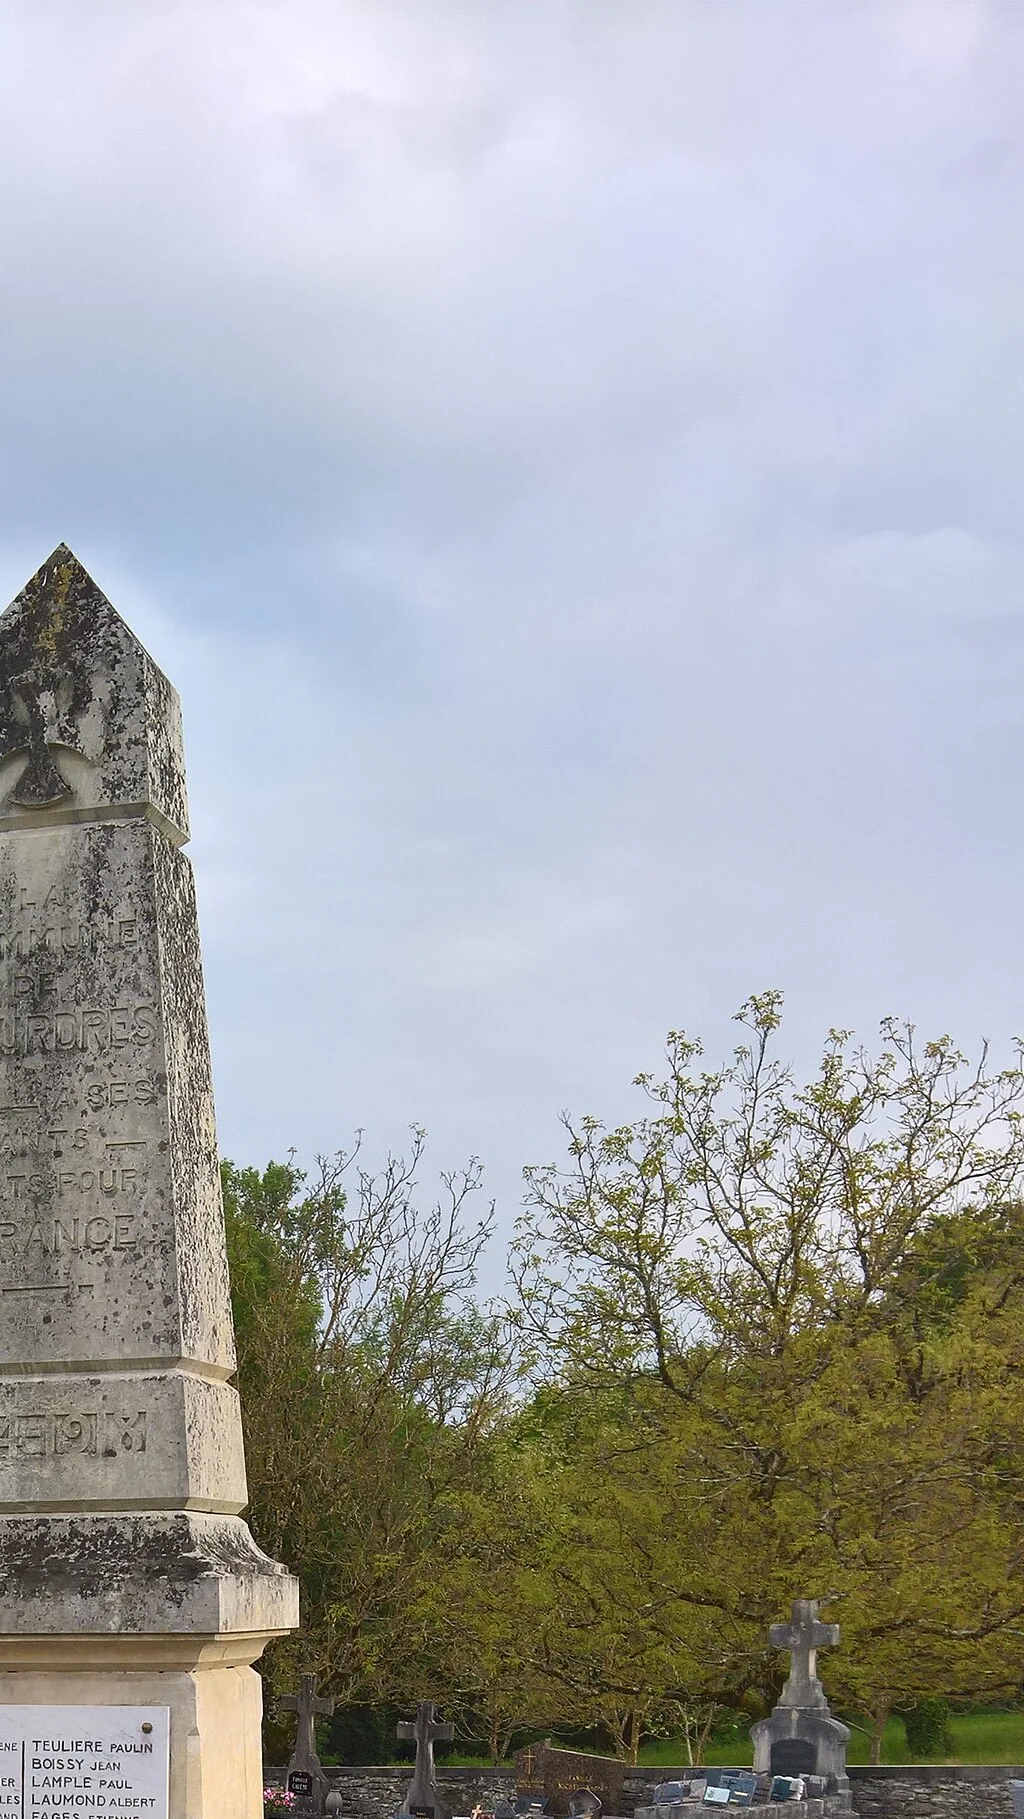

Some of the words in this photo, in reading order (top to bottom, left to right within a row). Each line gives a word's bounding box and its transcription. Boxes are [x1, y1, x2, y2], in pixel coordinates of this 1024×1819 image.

[20, 885, 66, 910] LA
[13, 972, 57, 998] DE
[87, 1080, 156, 1107] SES
[57, 1169, 139, 1197] POUR
[32, 1740, 103, 1752] TEULIERE
[110, 1743, 153, 1753] PAULIN
[32, 1758, 85, 1770] BOISSY
[90, 1761, 121, 1771] JEAN
[32, 1776, 92, 1788] LAMPLE
[99, 1780, 133, 1789] PAUL
[31, 1794, 106, 1806] LAUMOND
[109, 1797, 156, 1808] ALBERT
